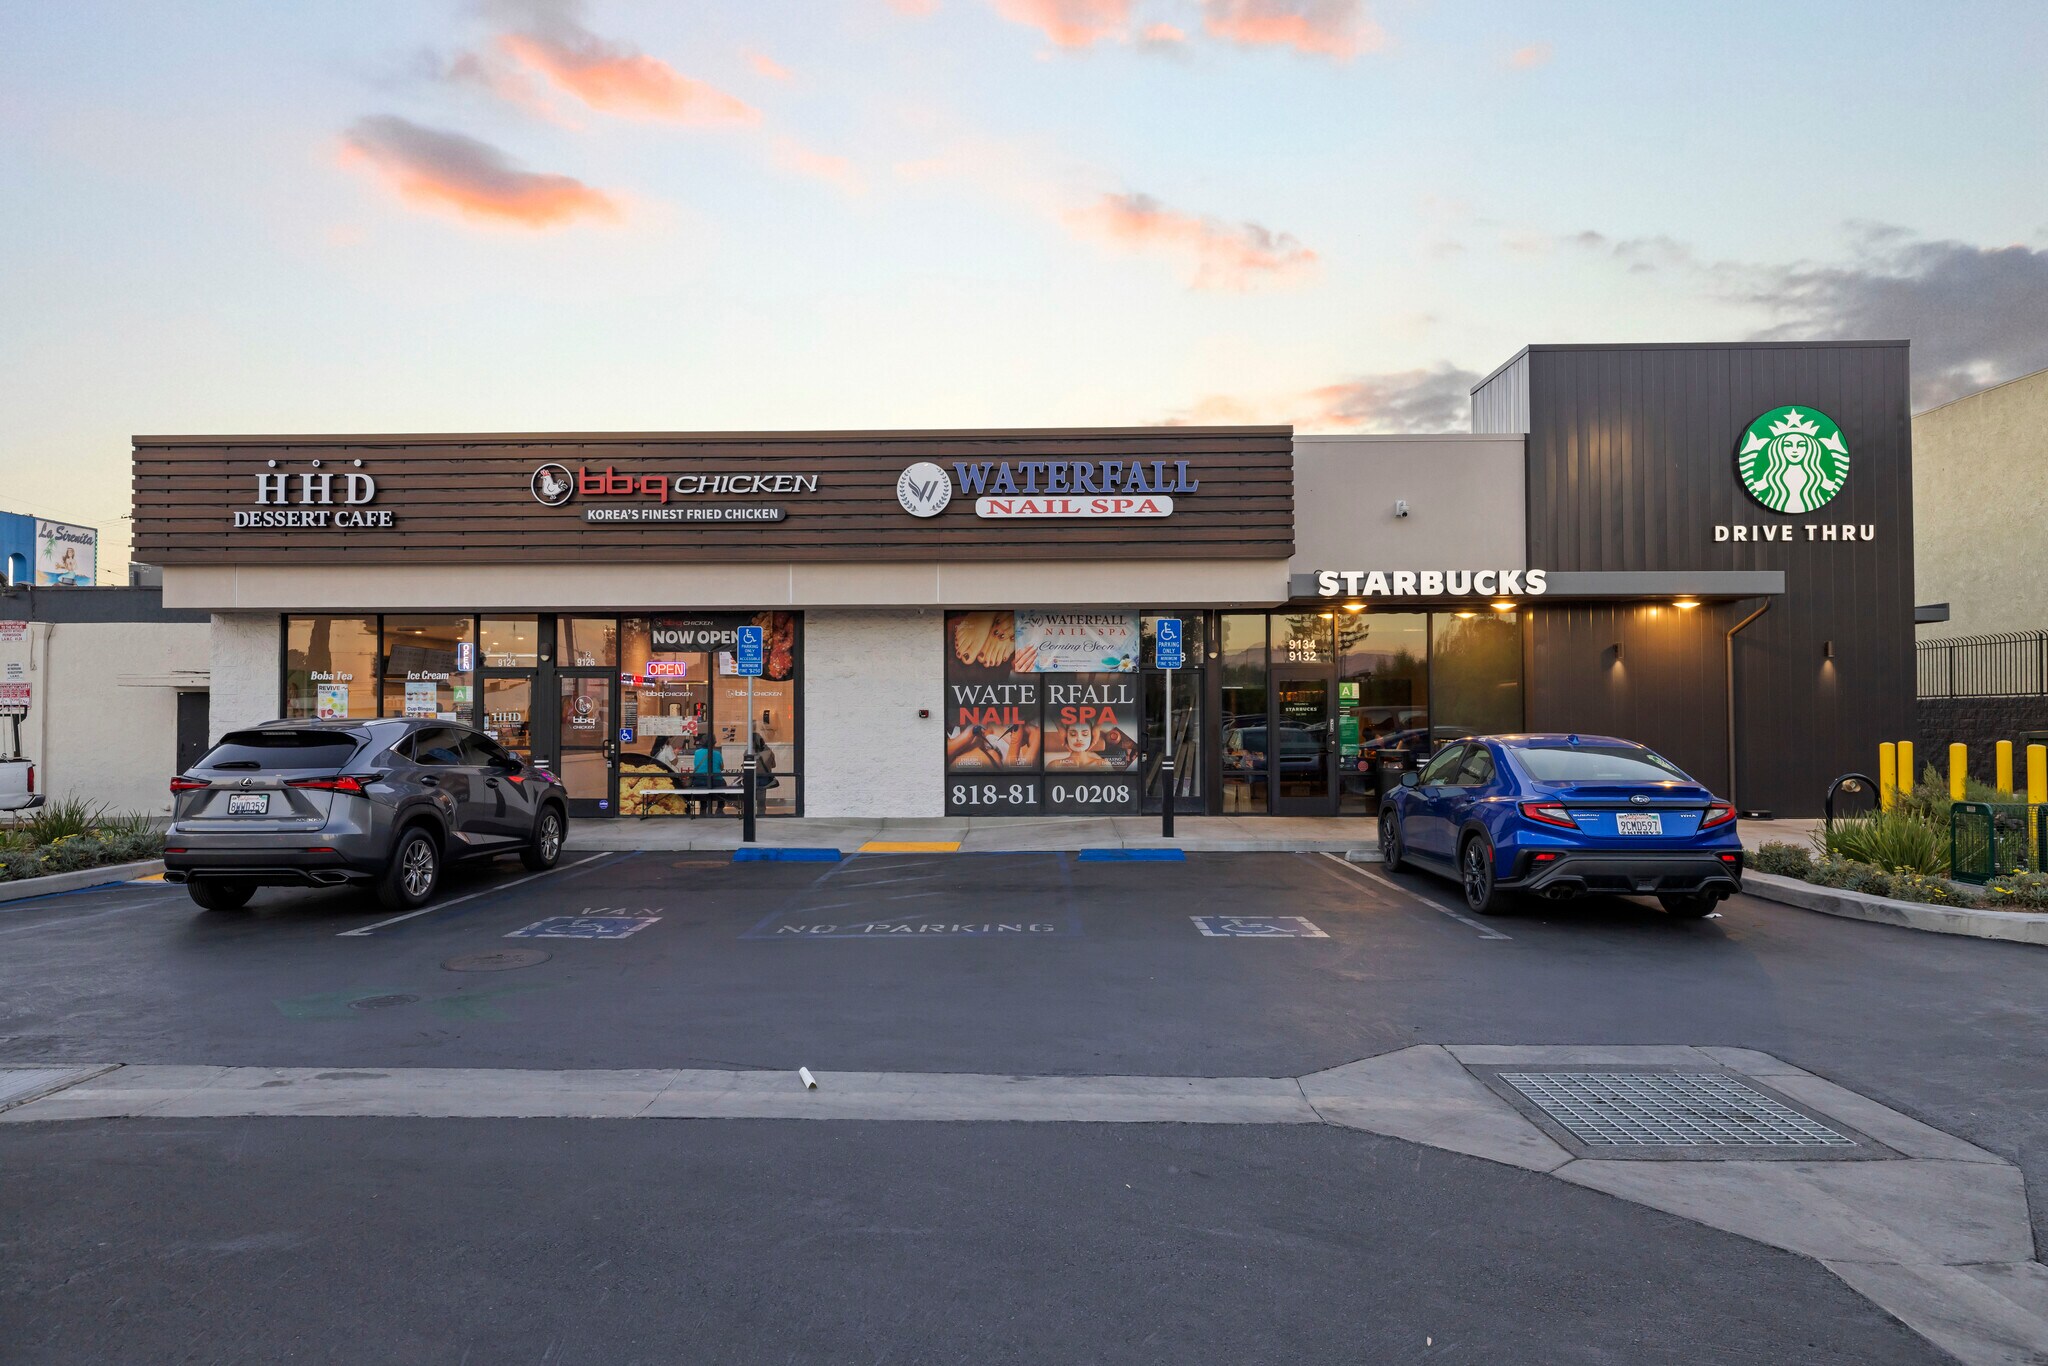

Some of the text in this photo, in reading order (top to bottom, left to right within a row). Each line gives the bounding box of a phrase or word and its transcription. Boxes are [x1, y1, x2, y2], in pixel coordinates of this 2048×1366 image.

[953, 461, 1199, 494] WATERFALL
[255, 473, 376, 504] HHD
[674, 475, 818, 494] CHICKEN
[986, 498, 1162, 515] NAIL SPA
[233, 510, 393, 528] DESSERT CAFE
[587, 507, 779, 521] KOREA’S FINEST FRIED CHICKEN
[38, 522, 94, 546] La Sirenita
[1714, 524, 1875, 542] DRIVE THRU
[1318, 569, 1547, 596] STARBUCKS
[1046, 614, 1127, 625] WATERFALL
[652, 630, 738, 644] NOW OPEN
[1046, 627, 1127, 636] NAIL SPA
[1039, 641, 1115, 652] Coming Soon
[1288, 639, 1317, 650] 9134
[1288, 651, 1317, 661] 9132
[498, 659, 516, 667] 9124
[577, 658, 595, 667] 9126
[407, 670, 449, 680] Ice Cream
[649, 664, 683, 675] OPEN
[311, 671, 353, 680] Boba Tea
[456, 690, 464, 699] A
[952, 685, 1134, 704] WATE RFALL
[1341, 686, 1350, 696] A
[493, 713, 521, 722] HHD
[959, 706, 1119, 725] NAIL SPA
[952, 784, 1130, 805] 818-81 0-0208
[1620, 821, 1657, 831] 9CMD597
[776, 924, 1053, 934] NO PARKING
